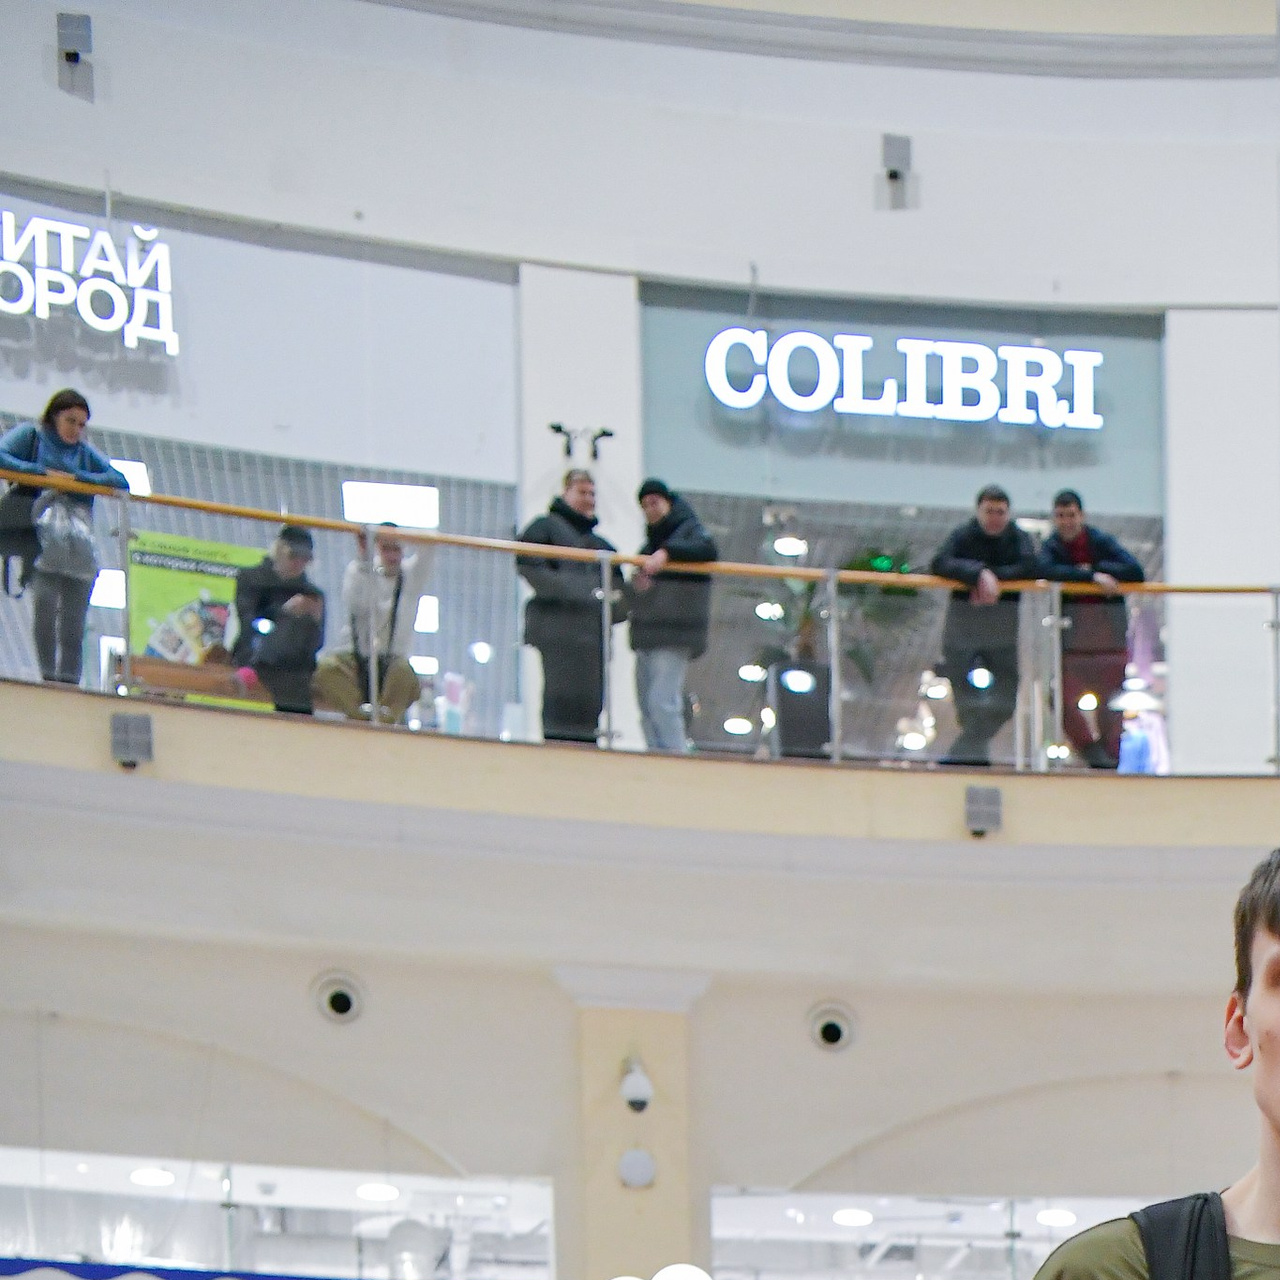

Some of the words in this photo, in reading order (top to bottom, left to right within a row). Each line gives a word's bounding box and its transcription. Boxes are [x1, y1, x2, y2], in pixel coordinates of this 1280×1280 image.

[1, 210, 172, 293] ИТАЙ
[0, 260, 180, 357] ОРОД
[704, 326, 1103, 430] COLIBRI
